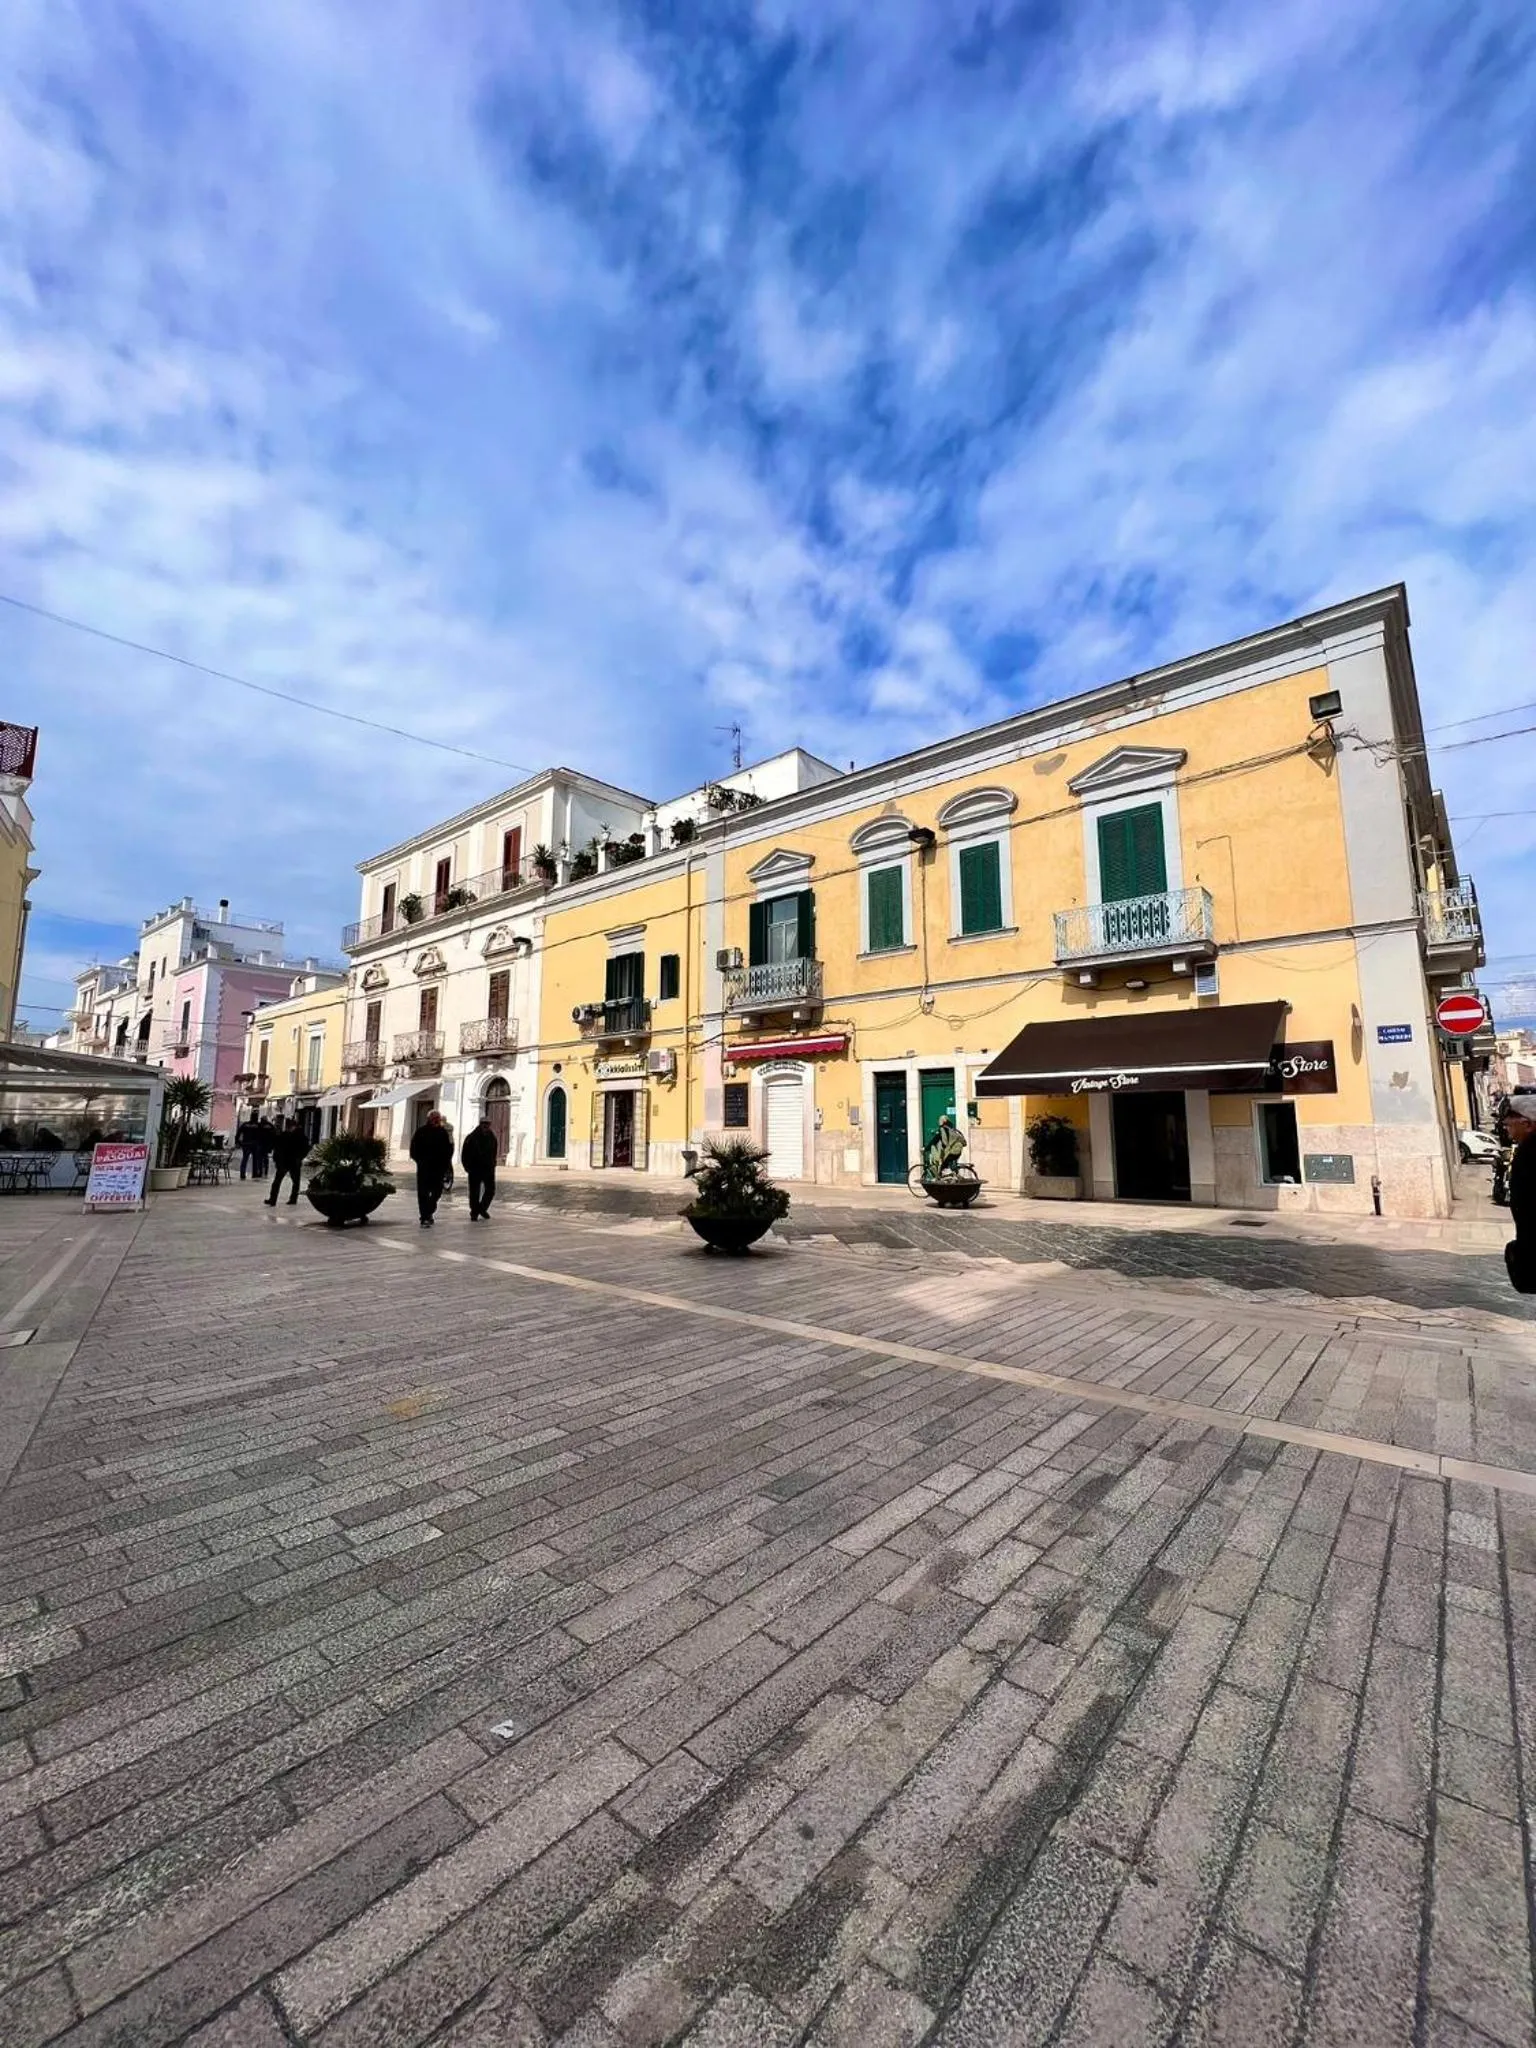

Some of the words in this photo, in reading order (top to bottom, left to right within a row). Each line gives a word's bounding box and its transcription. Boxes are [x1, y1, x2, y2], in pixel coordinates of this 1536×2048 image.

[1278, 1056, 1328, 1078] Store
[1071, 1077, 1108, 1094] Vintage
[1109, 1073, 1139, 1089] Store
